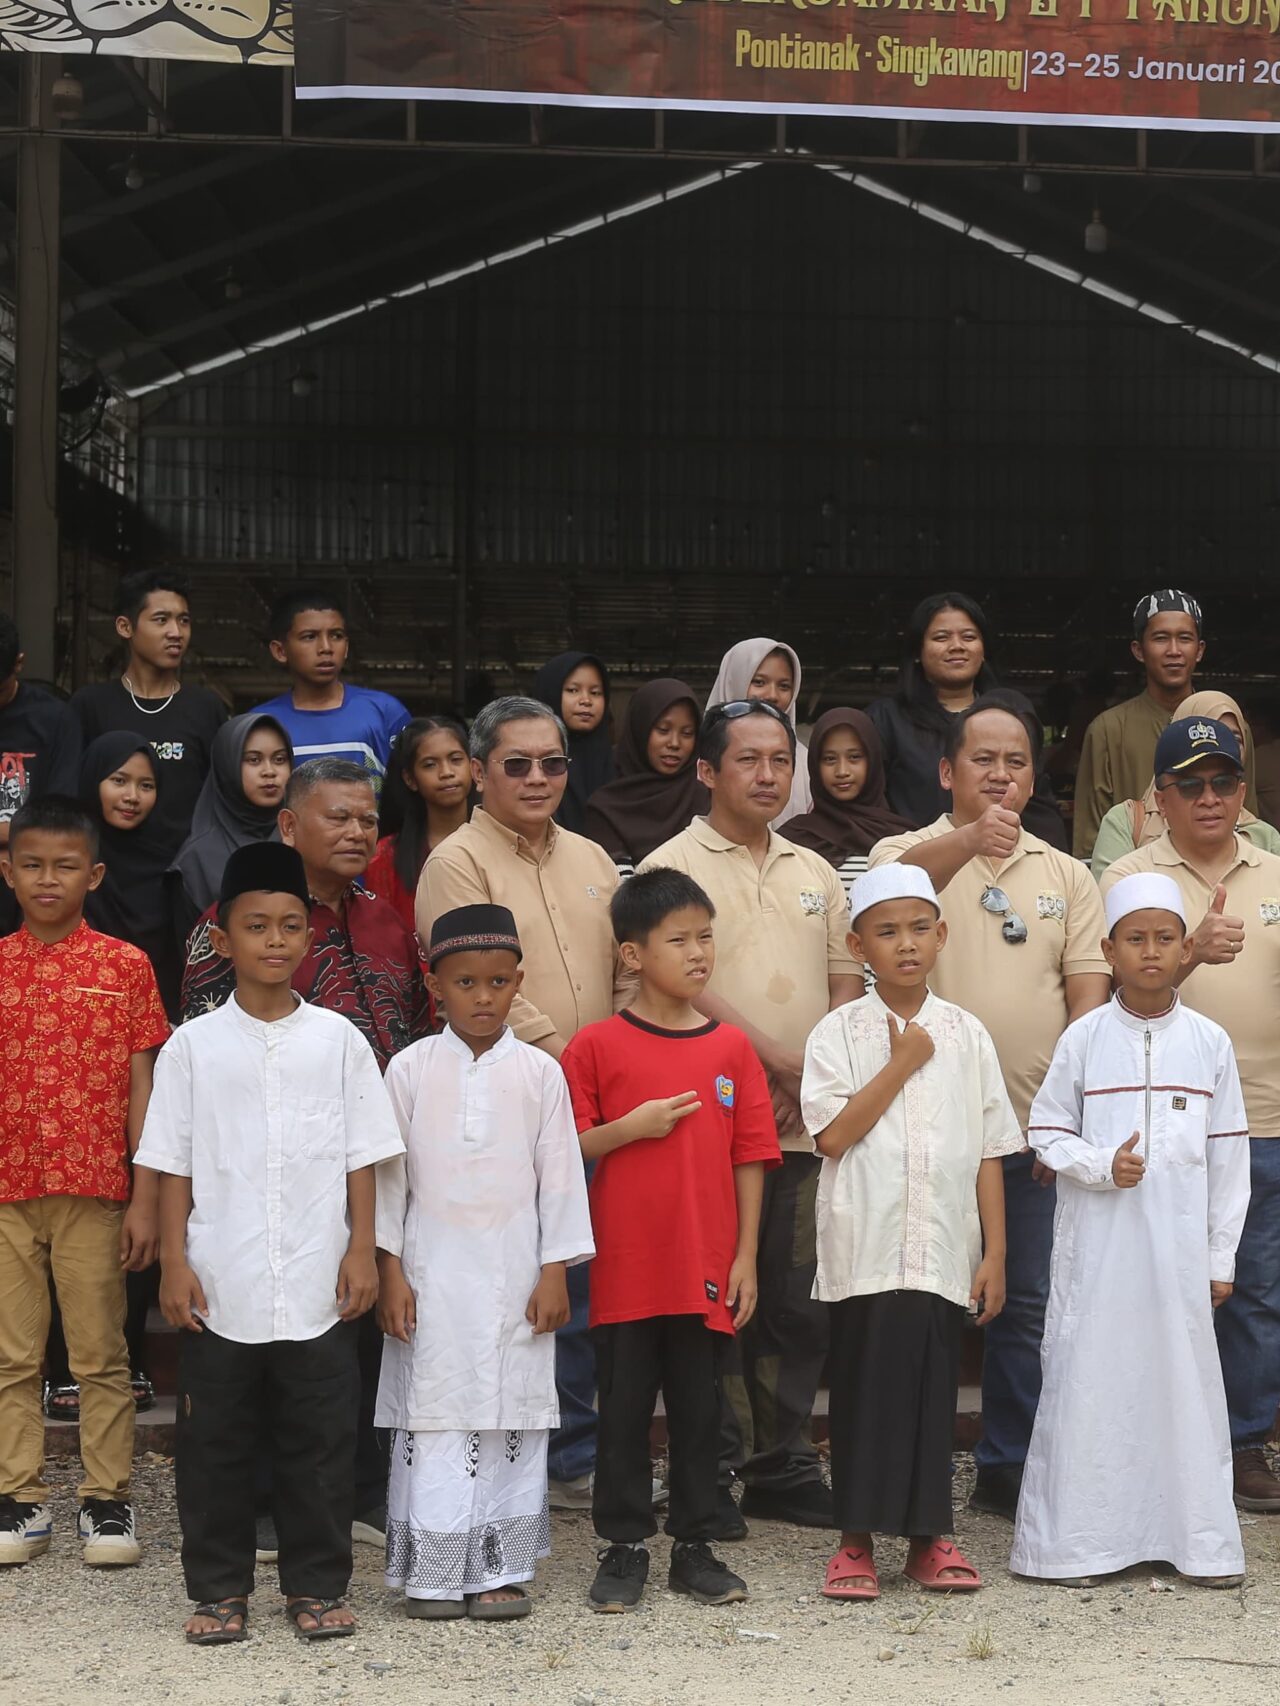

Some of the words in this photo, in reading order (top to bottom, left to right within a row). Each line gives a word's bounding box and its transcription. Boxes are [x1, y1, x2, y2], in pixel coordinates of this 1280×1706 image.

[735, 29, 860, 72] Pontianak
[876, 38, 1023, 87] Singkawang
[1030, 51, 1121, 79] 23-25
[1128, 55, 1245, 84] Januari
[1188, 724, 1217, 740] 699
